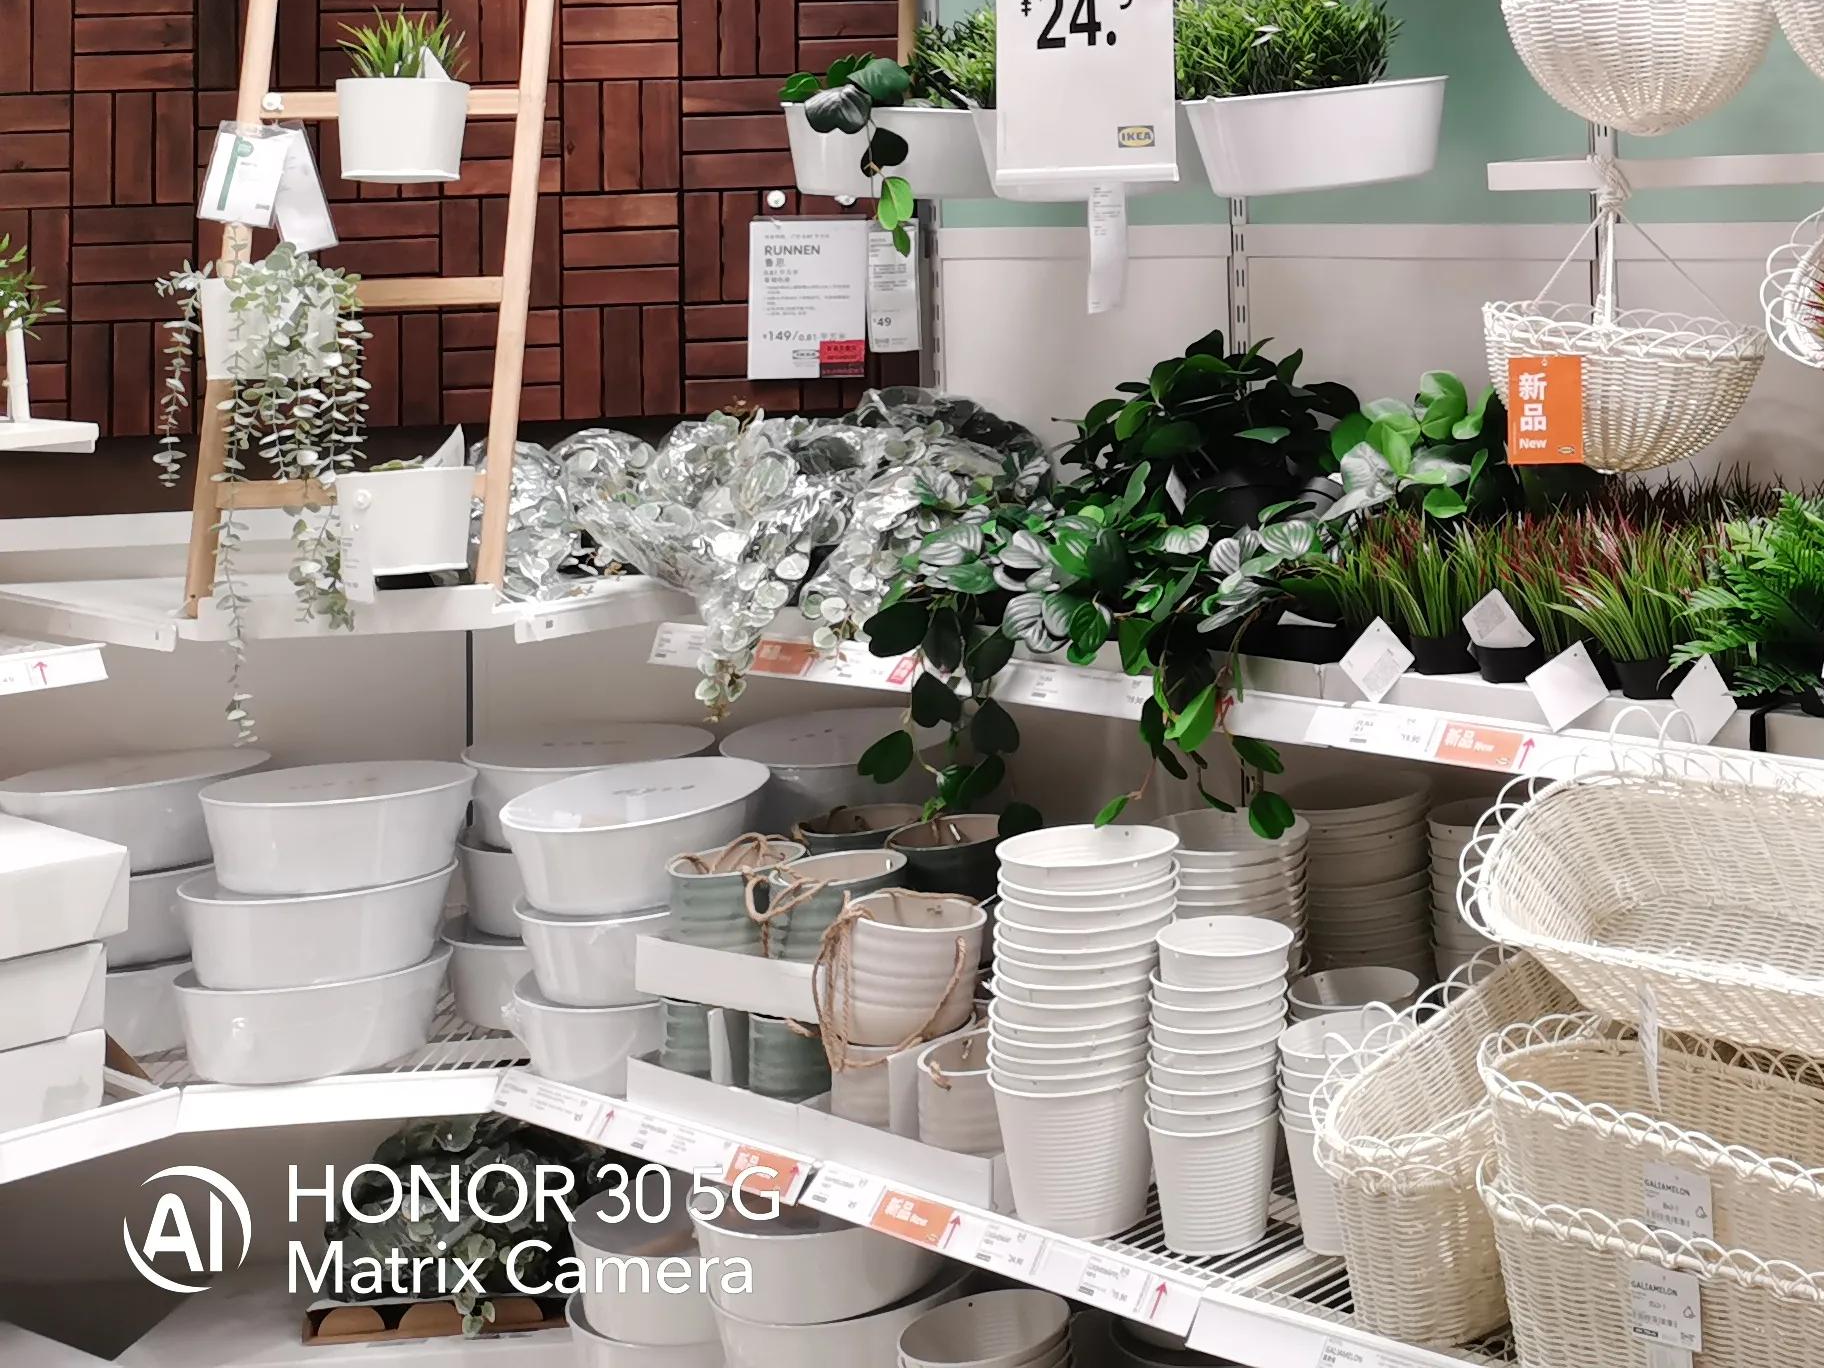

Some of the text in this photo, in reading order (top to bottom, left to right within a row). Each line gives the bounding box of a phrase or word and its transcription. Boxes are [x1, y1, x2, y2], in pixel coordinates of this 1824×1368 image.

[1121, 130, 1152, 143] IKEA
[764, 244, 821, 256] RUNNEN
[1518, 372, 1548, 432] 新品
[1519, 438, 1547, 449] New
[1445, 727, 1476, 750] 新品
